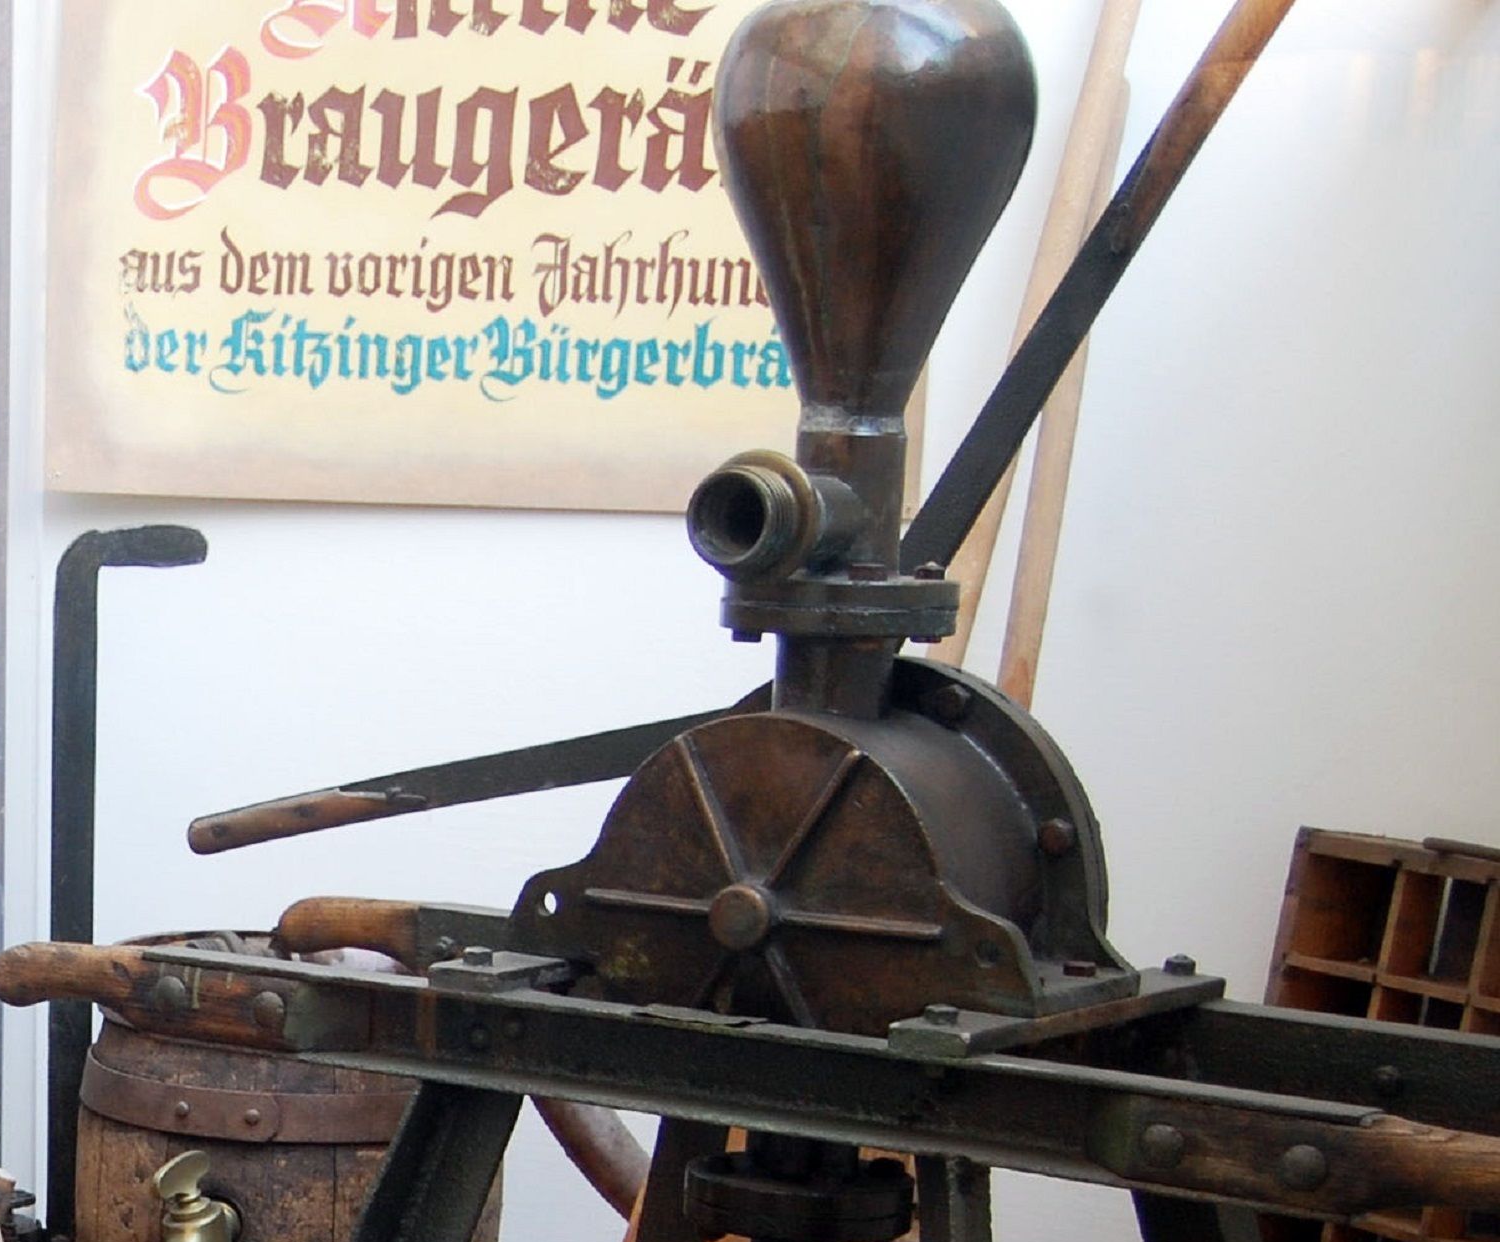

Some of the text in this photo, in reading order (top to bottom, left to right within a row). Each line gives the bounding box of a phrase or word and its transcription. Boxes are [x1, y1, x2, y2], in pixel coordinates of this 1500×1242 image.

[134, 44, 724, 221] Braugerä
[119, 226, 769, 319] aus dem vorigen Jahrhun
[122, 302, 207, 375] der
[209, 308, 479, 395] Kitzinger
